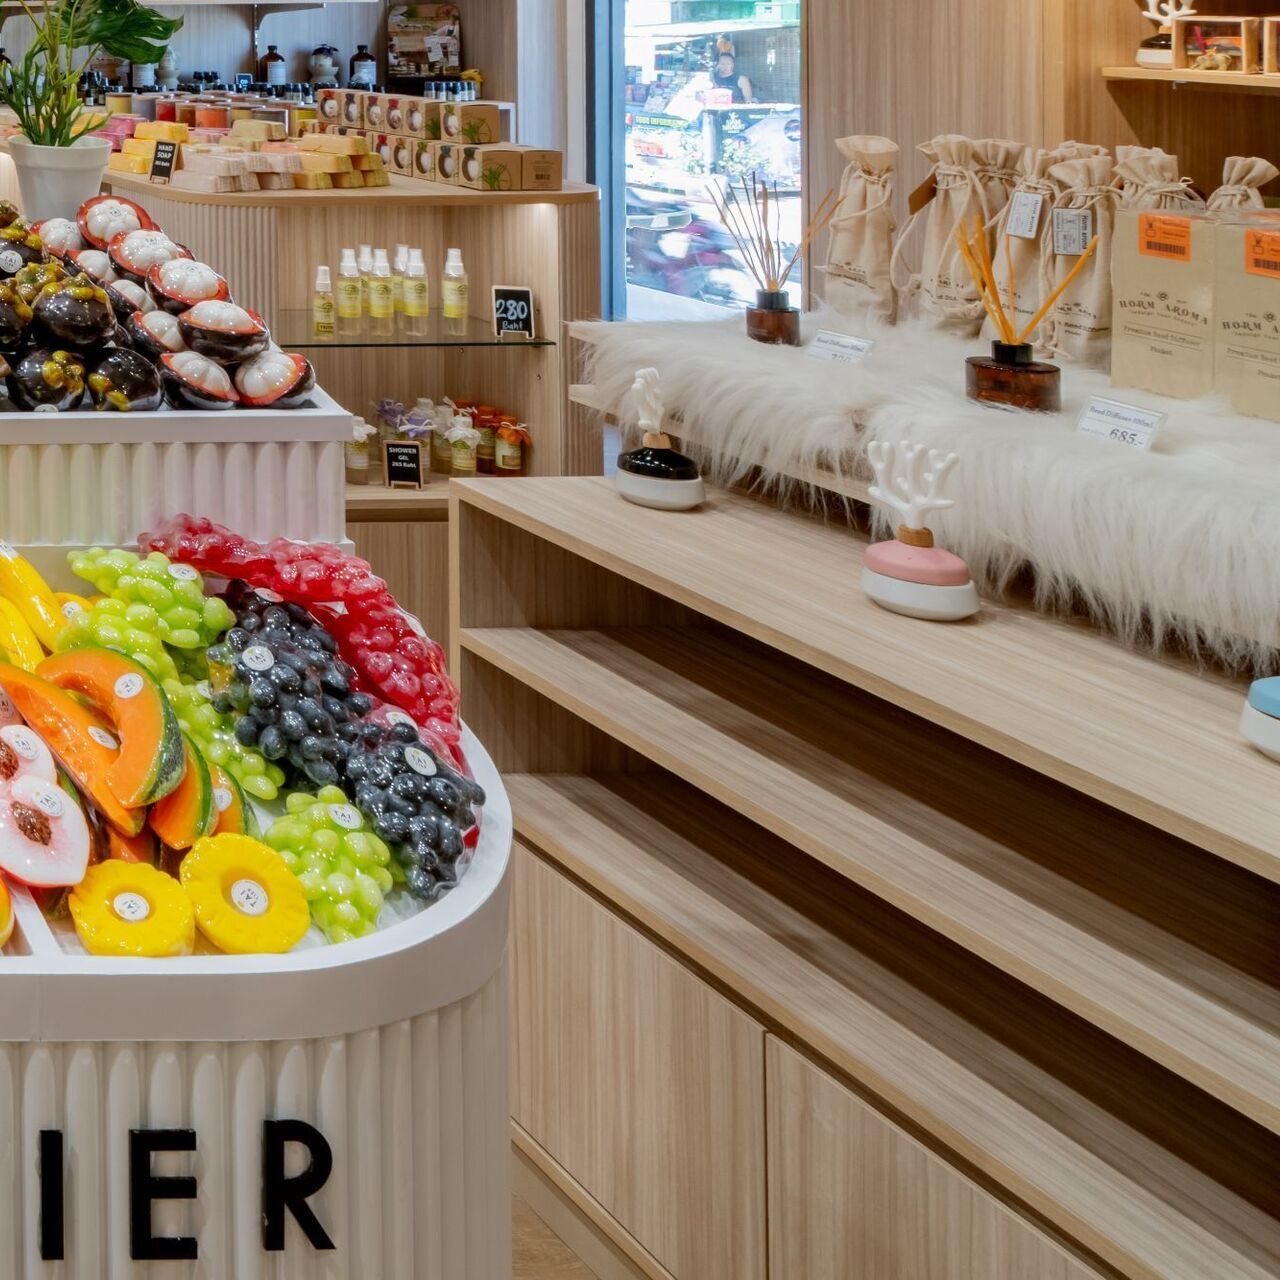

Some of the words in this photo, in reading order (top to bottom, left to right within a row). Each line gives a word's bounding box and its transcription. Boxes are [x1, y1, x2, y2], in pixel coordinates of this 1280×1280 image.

[1081, 214, 1089, 230] Horm
[1119, 300, 1155, 310] HORM
[1166, 303, 1208, 325] AROMA
[1222, 322, 1261, 330] HORM
